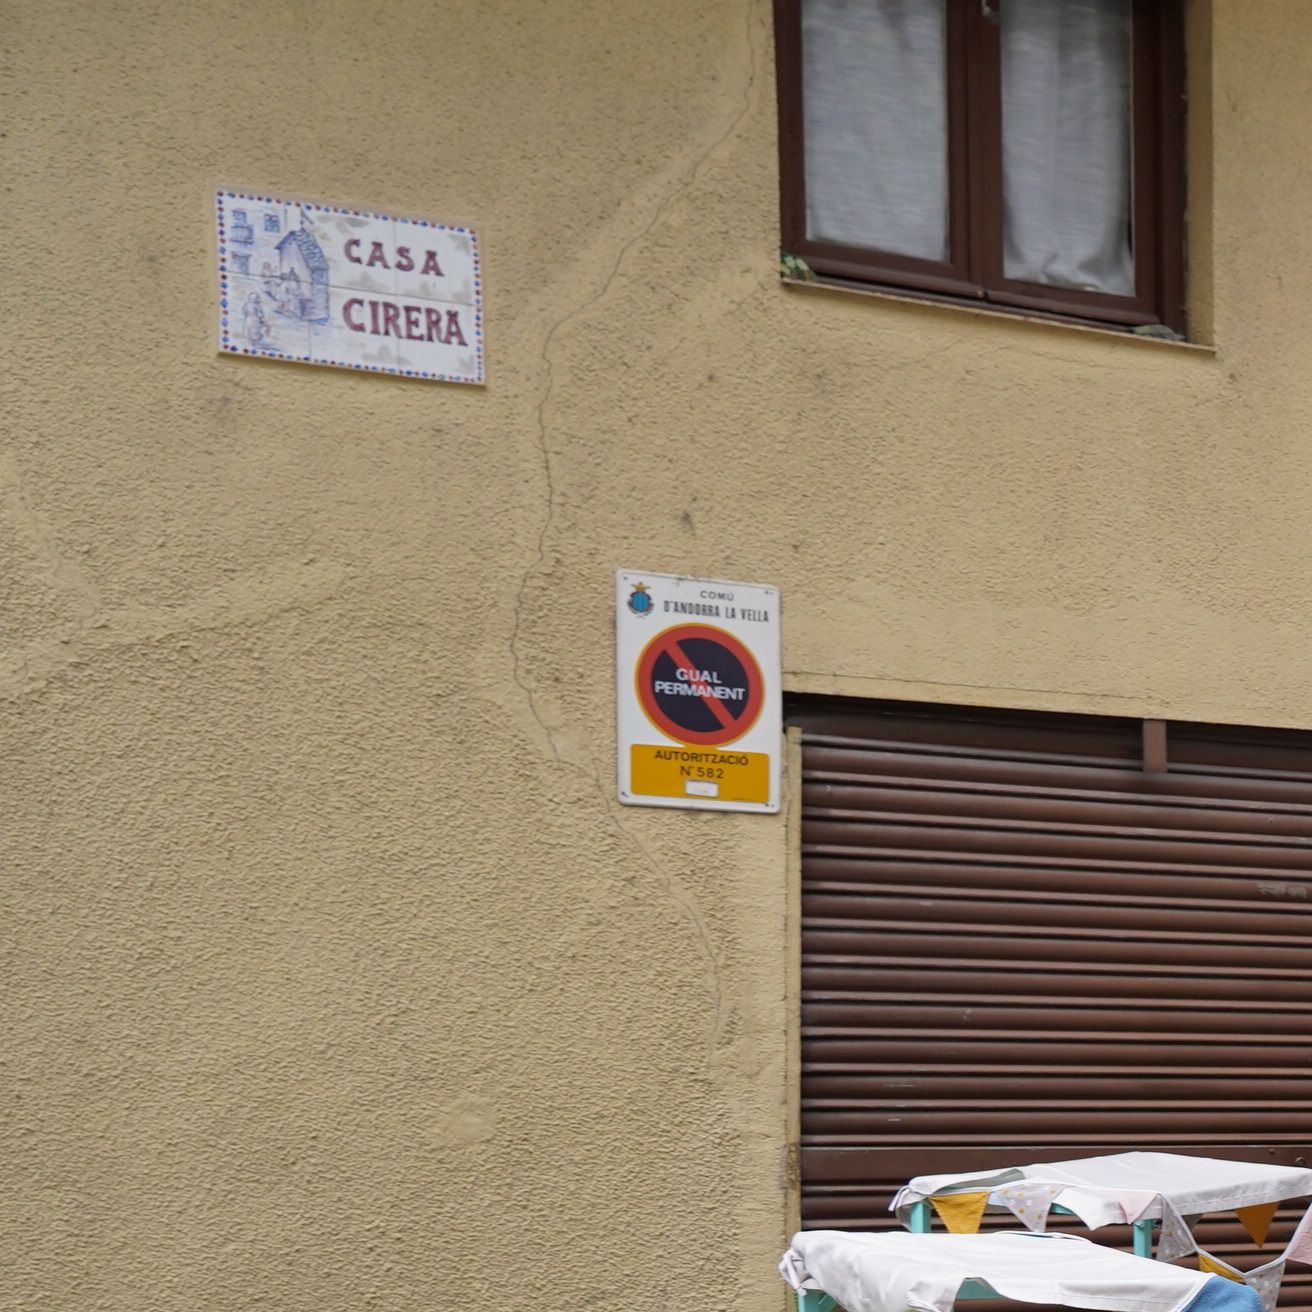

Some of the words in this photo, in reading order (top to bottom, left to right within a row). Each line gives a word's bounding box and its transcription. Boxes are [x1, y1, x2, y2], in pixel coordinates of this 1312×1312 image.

[344, 238, 445, 277] CASA
[342, 297, 469, 347] CIRERA
[664, 600, 721, 618] D'ANDORRA
[725, 606, 736, 619] LA
[741, 608, 769, 622] VELLA
[676, 667, 722, 684] GUAL
[654, 680, 747, 701] PERMANENT
[654, 750, 749, 766] AUTORITZACIÓ
